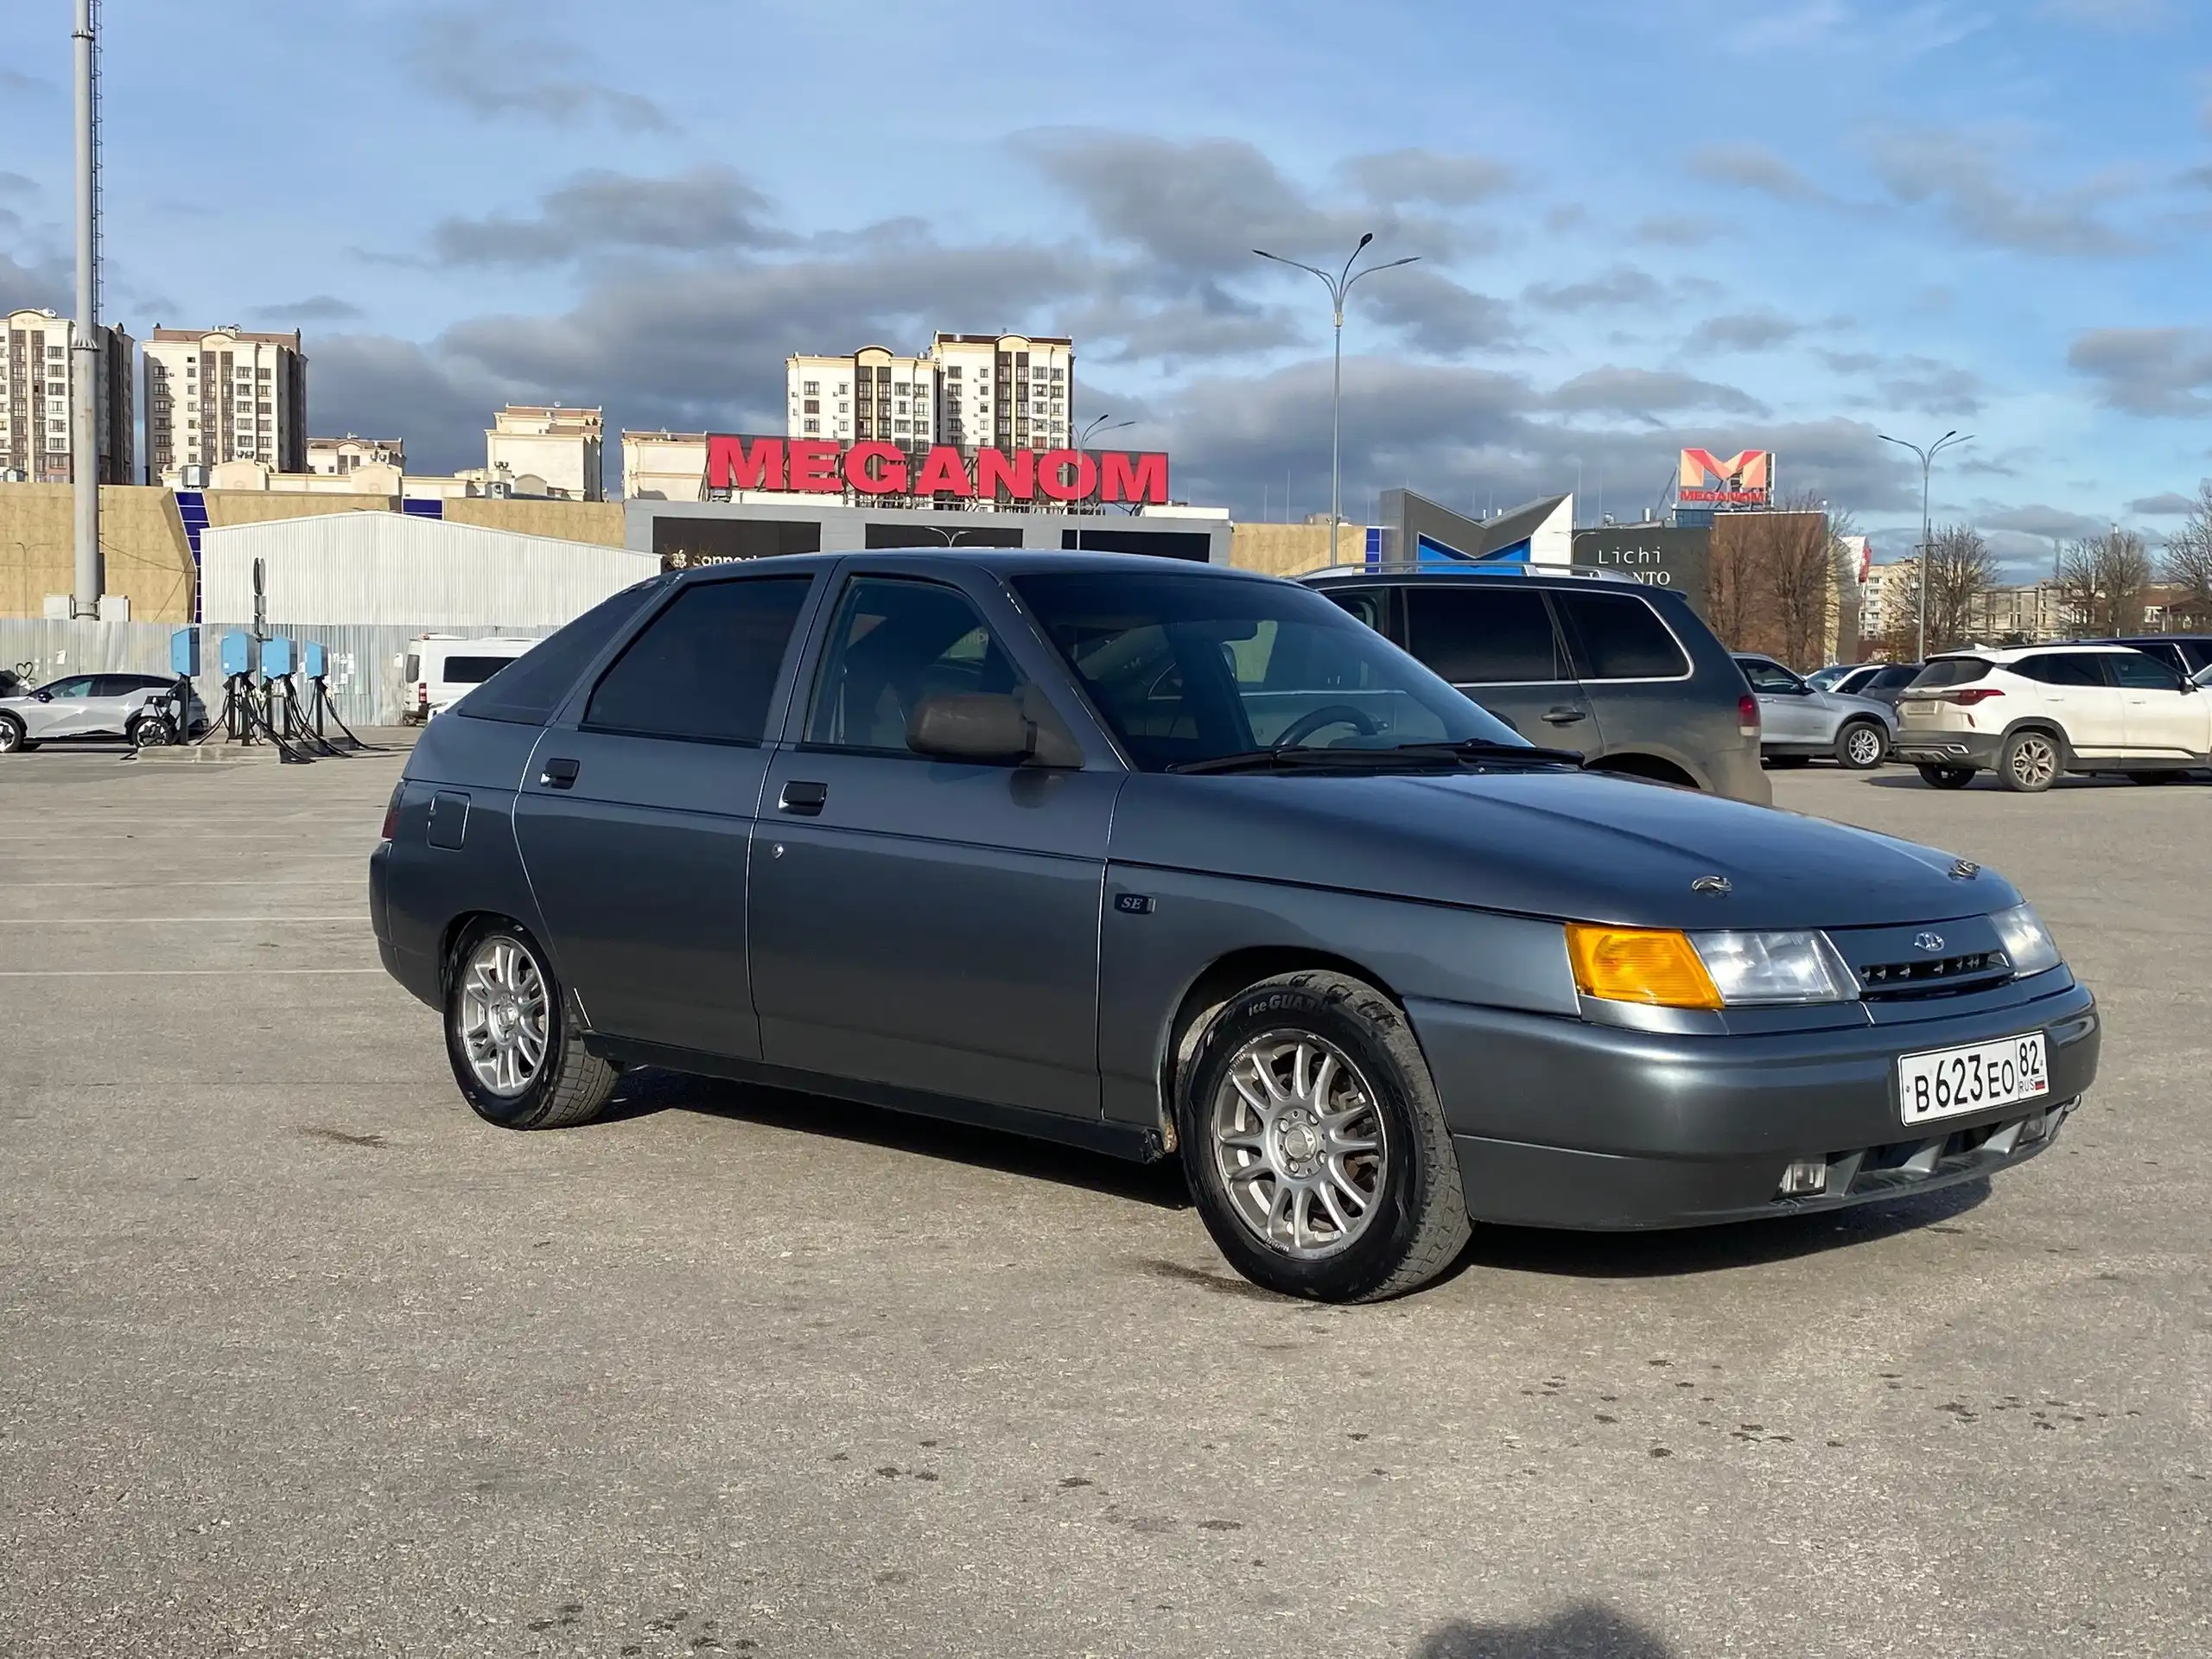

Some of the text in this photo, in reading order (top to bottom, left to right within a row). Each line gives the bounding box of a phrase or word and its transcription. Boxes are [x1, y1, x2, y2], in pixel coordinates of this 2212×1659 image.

[709, 435, 1169, 504] MEGANOM
[1680, 492, 1764, 505] MEGANOM
[1598, 547, 1662, 564] Lichi
[1121, 897, 1143, 910] SE
[2019, 1040, 2039, 1077] 82
[2019, 1078, 2035, 1092] RUS
